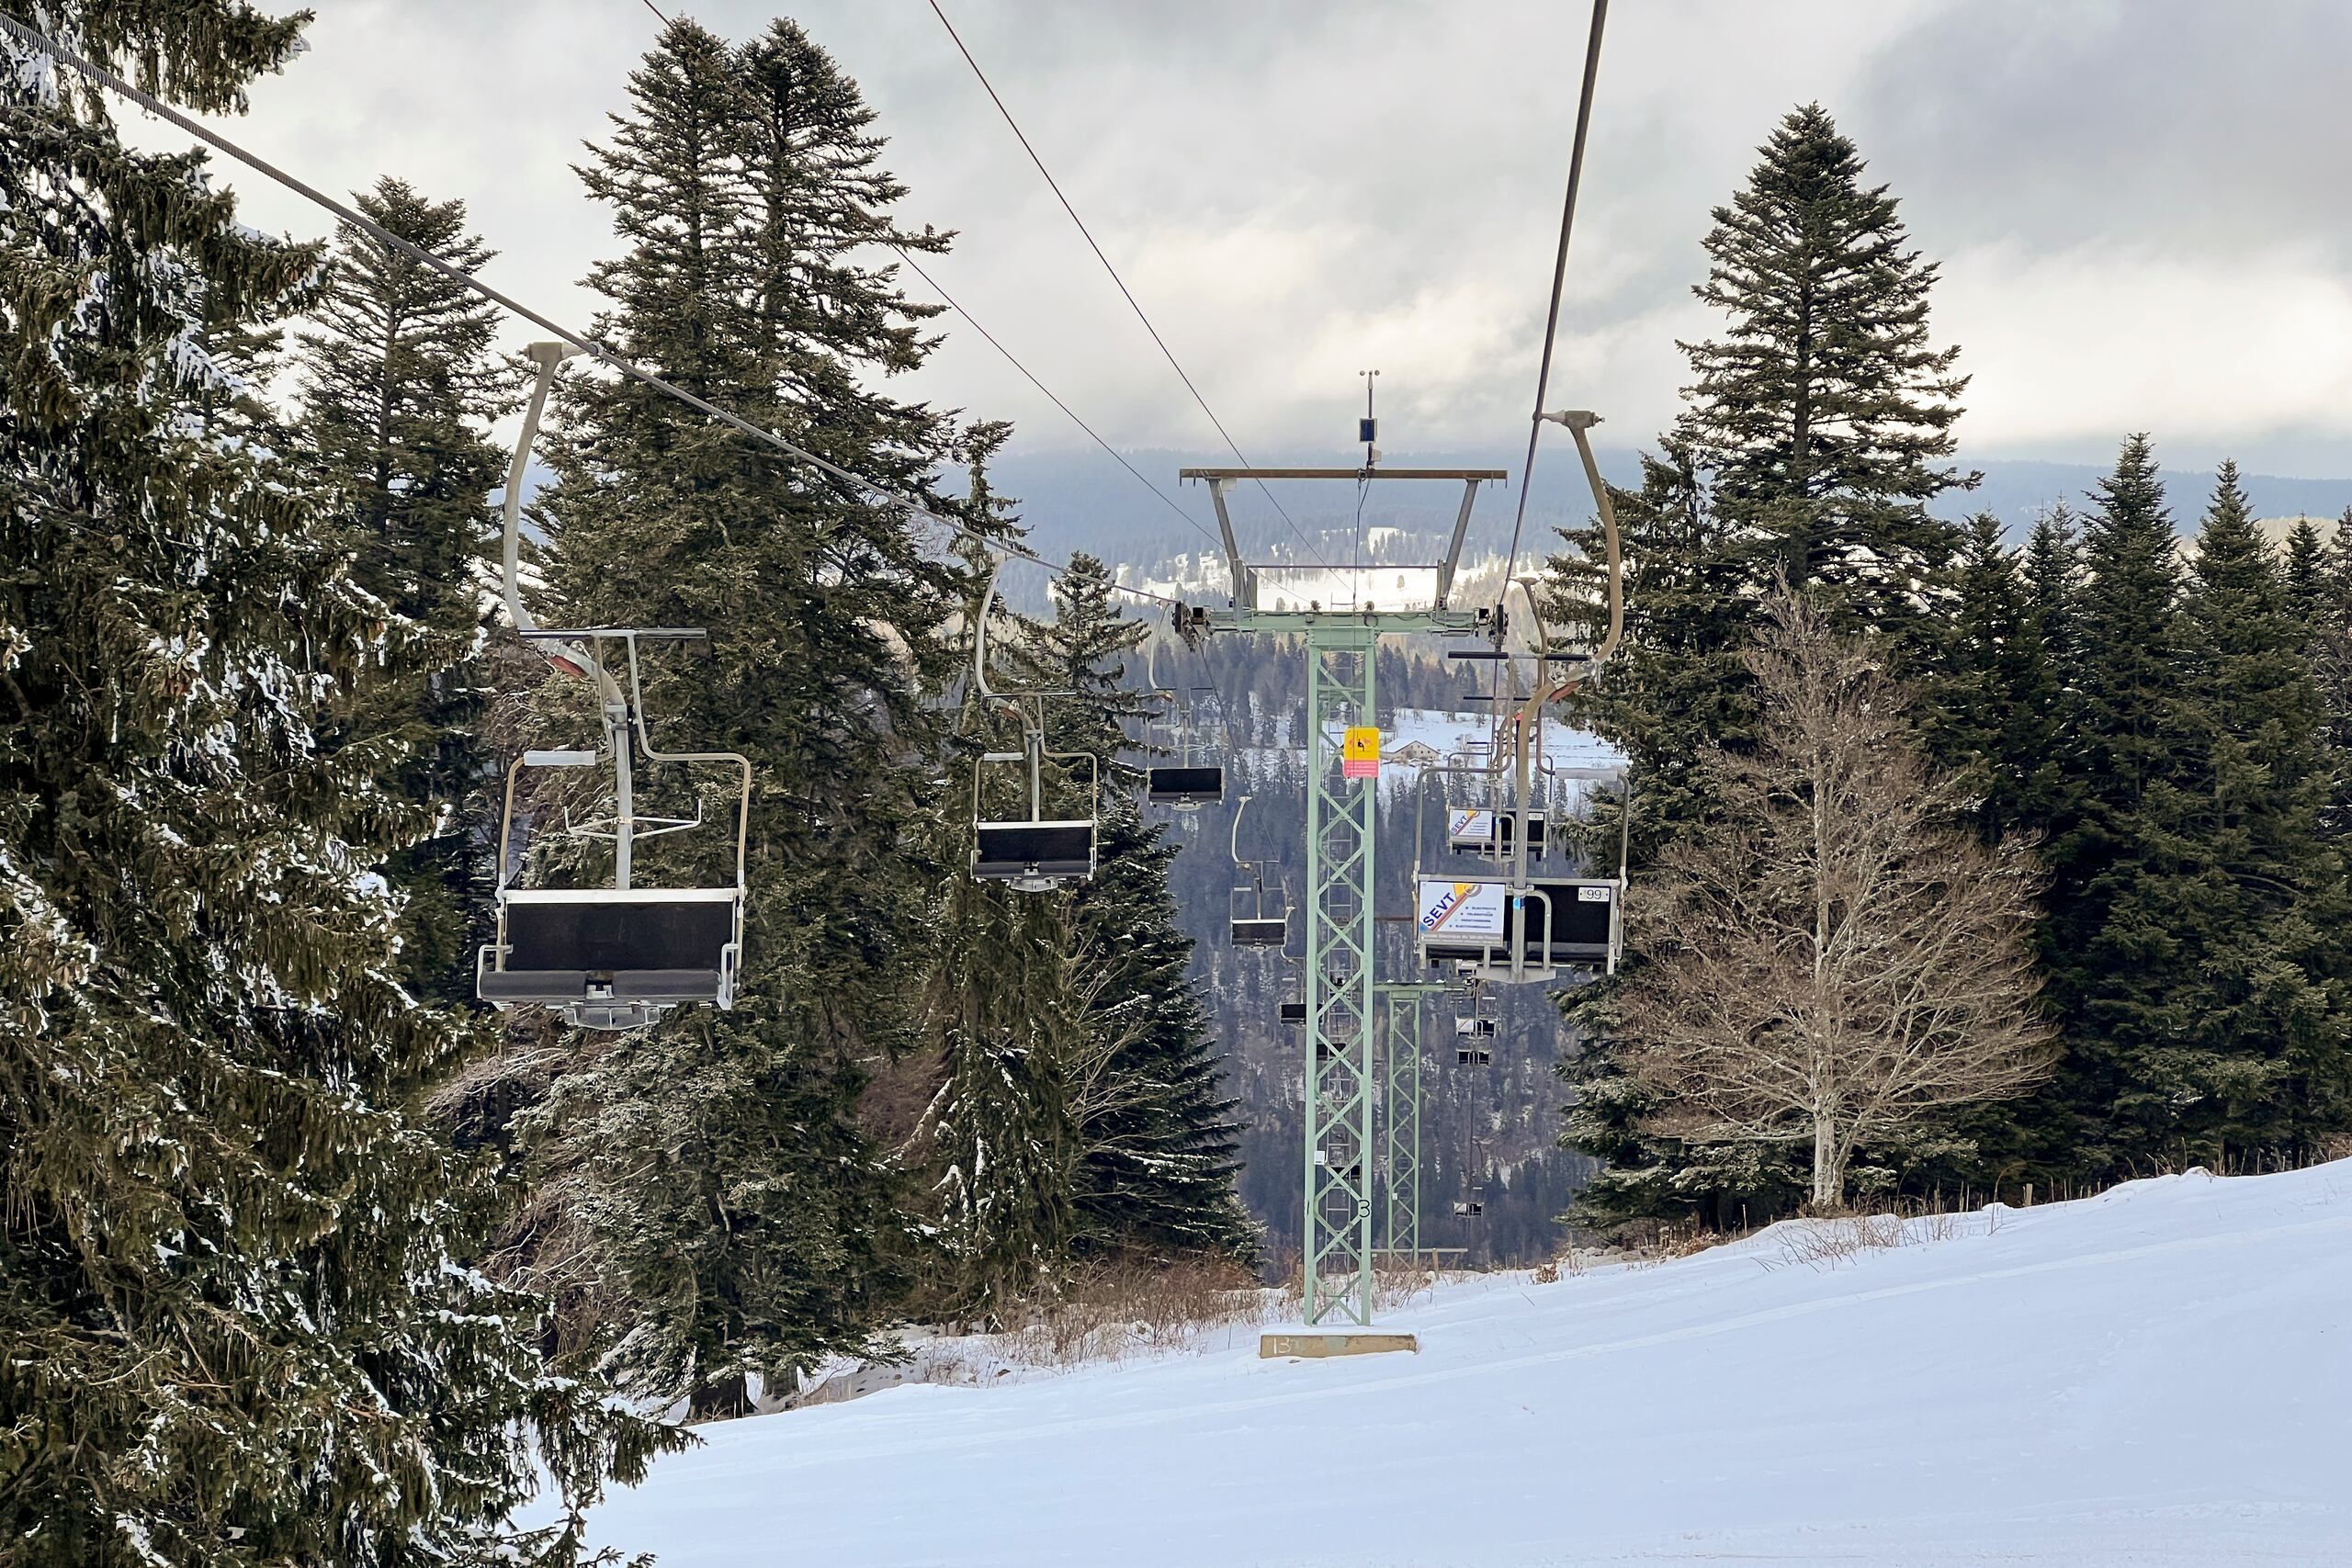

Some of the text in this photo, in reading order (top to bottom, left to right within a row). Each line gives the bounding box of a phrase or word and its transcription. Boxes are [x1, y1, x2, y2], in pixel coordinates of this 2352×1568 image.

[1451, 815, 1468, 833] SEVT
[1587, 889, 1601, 900] 99
[1423, 892, 1455, 927] SEVT
[1272, 1337, 1292, 1355] 13
